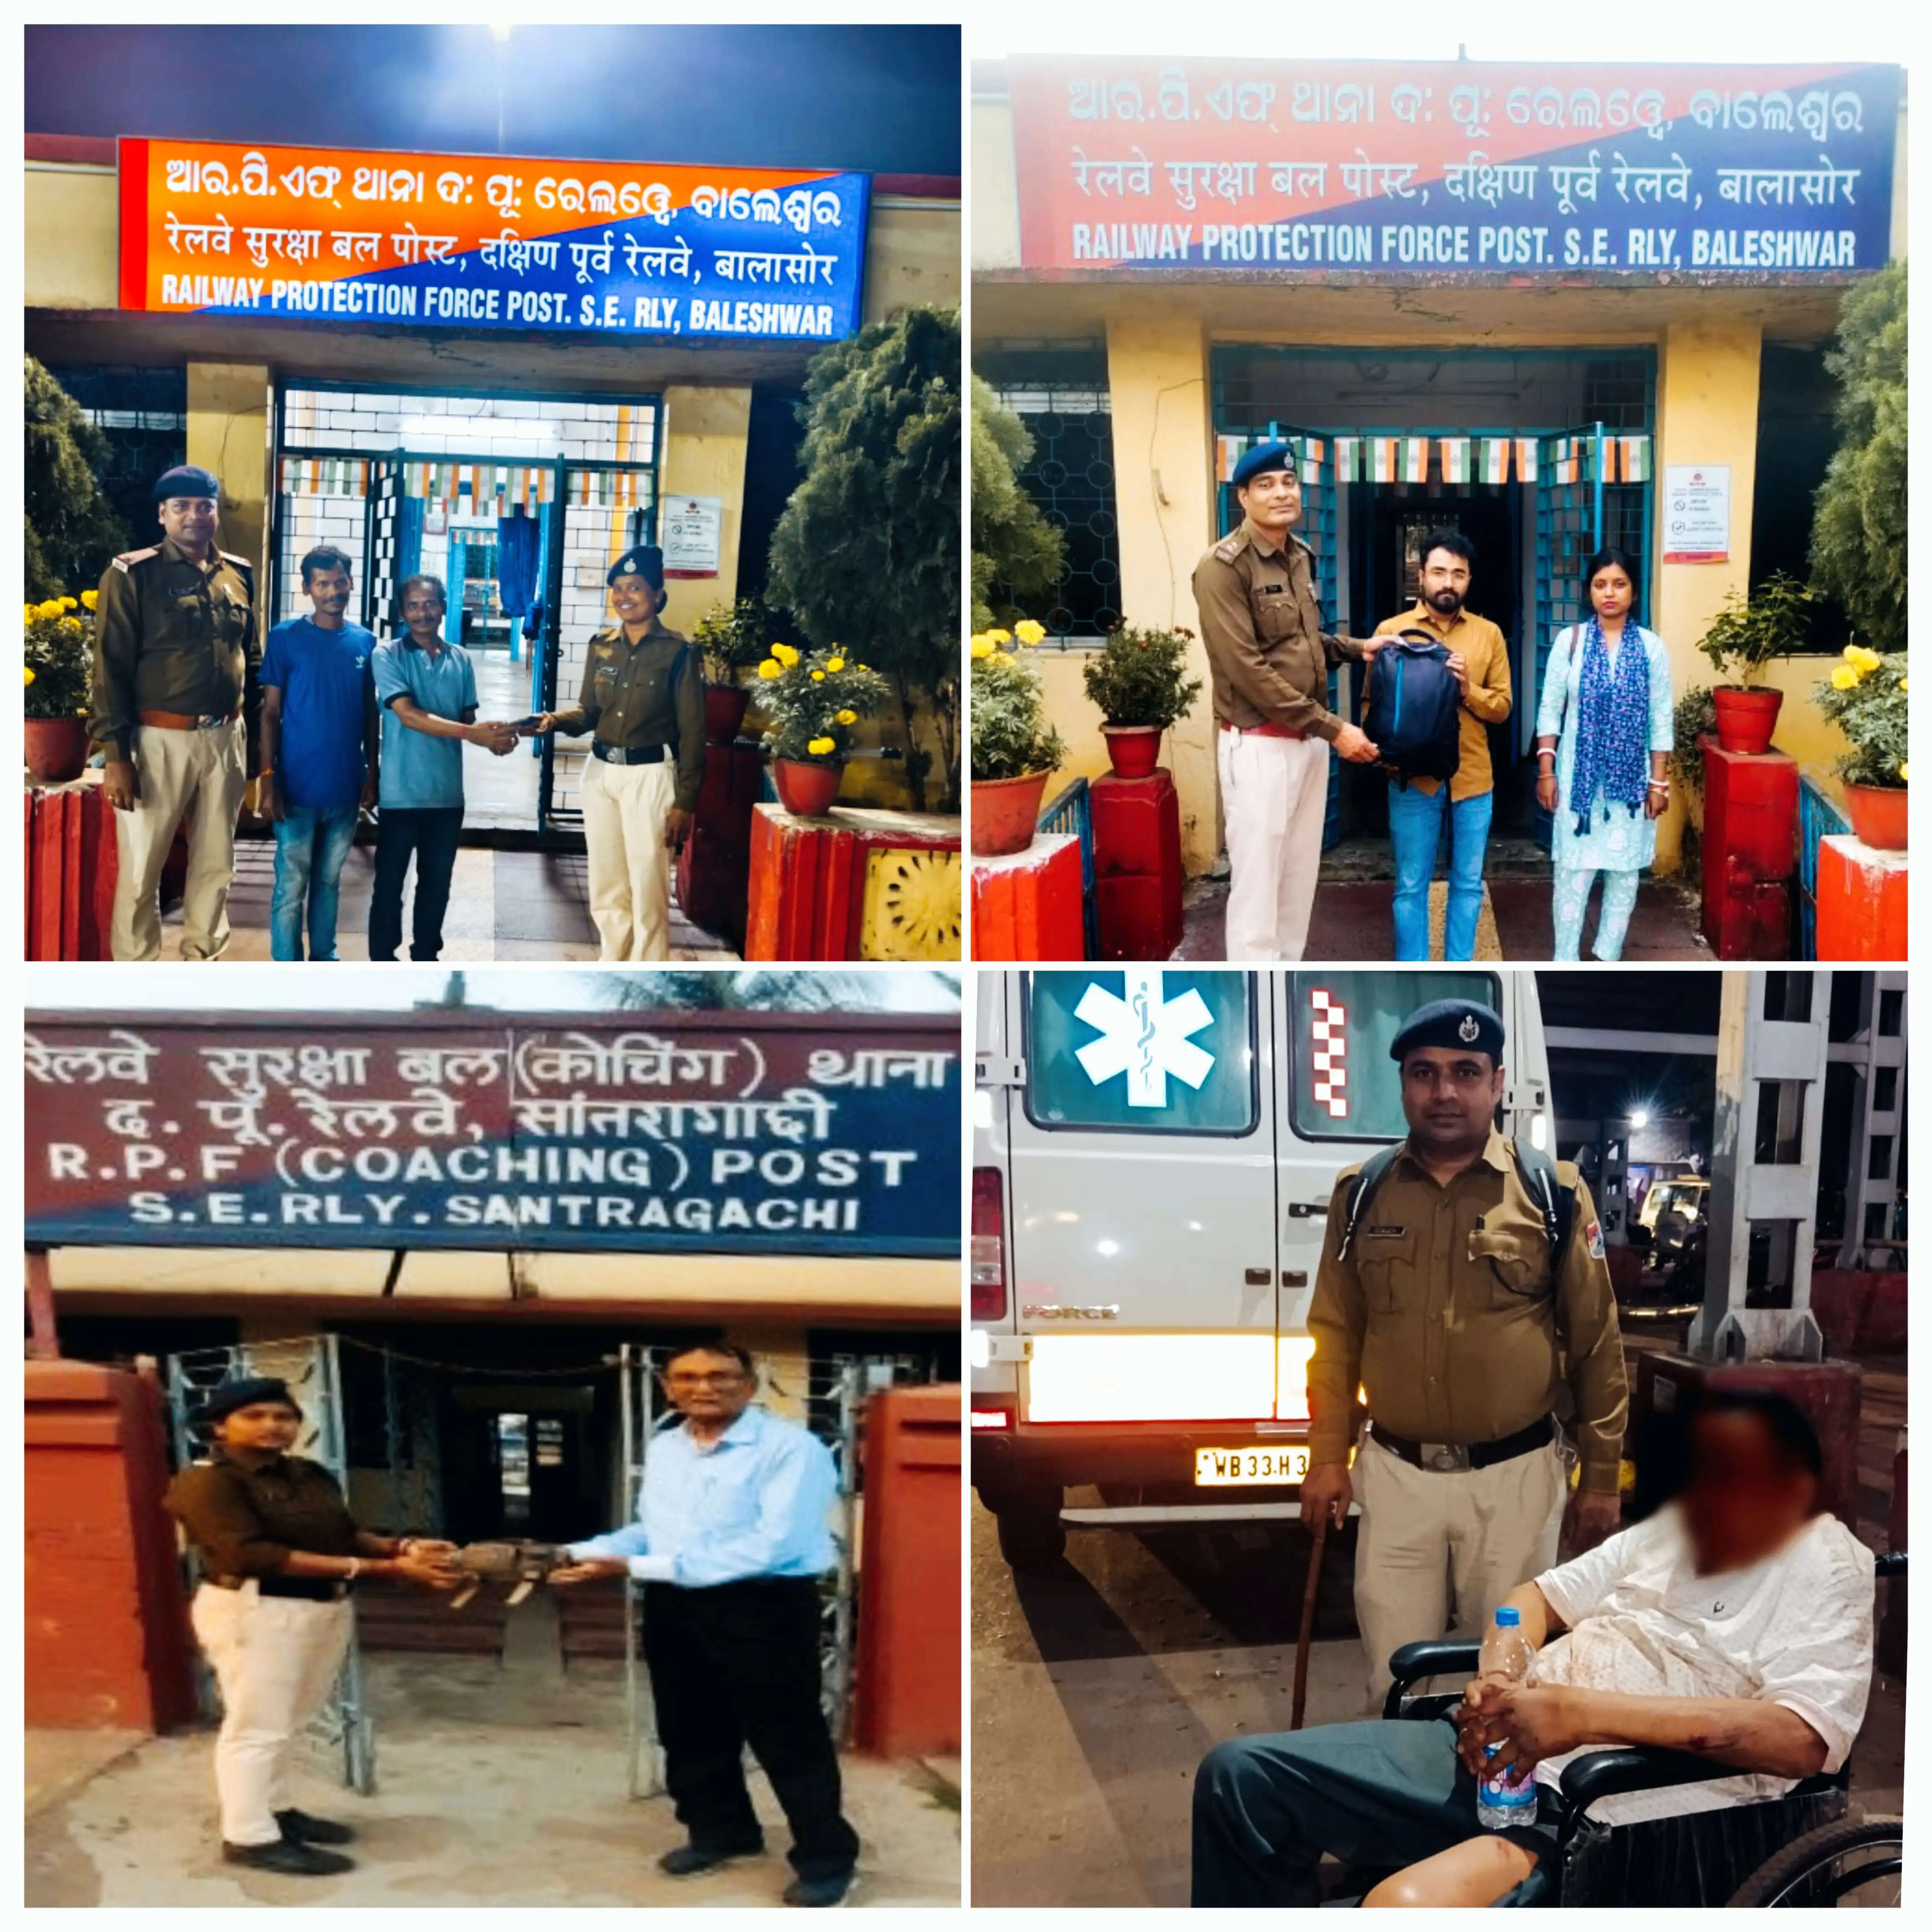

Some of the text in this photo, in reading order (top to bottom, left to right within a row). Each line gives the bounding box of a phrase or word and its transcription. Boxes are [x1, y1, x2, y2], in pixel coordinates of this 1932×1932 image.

[1292, 82, 1374, 123] ଥାନା
[353, 168, 423, 203] ଥାନା
[1071, 145, 1861, 214] रेलवे सुरक्षा बल पोस्ट, दक्षिण पूर्व रेलवे, बालासोर
[165, 212, 838, 284] रेलवे सुरक्षा बल पोस्ट, दक्षिण पूर्व रेलवे, बालासोर
[1072, 224, 1855, 270] RAILWAY PROTECTION FORCE POST. S.E. RLY, BALESHWAR
[162, 274, 833, 335] RAILWAY PROTECTION FORCE POST. S.E. RLY, BALESHWAR
[24, 1030, 161, 1084] रेलवे
[200, 1046, 371, 1105] सुरक्षा
[398, 1046, 507, 1085] बल
[808, 1049, 955, 1087] थाना
[48, 1139, 917, 1191] R.P.F (COACHING) POST
[446, 1194, 860, 1232] SANTRAGACHI
[1022, 1304, 1119, 1319] FORCE
